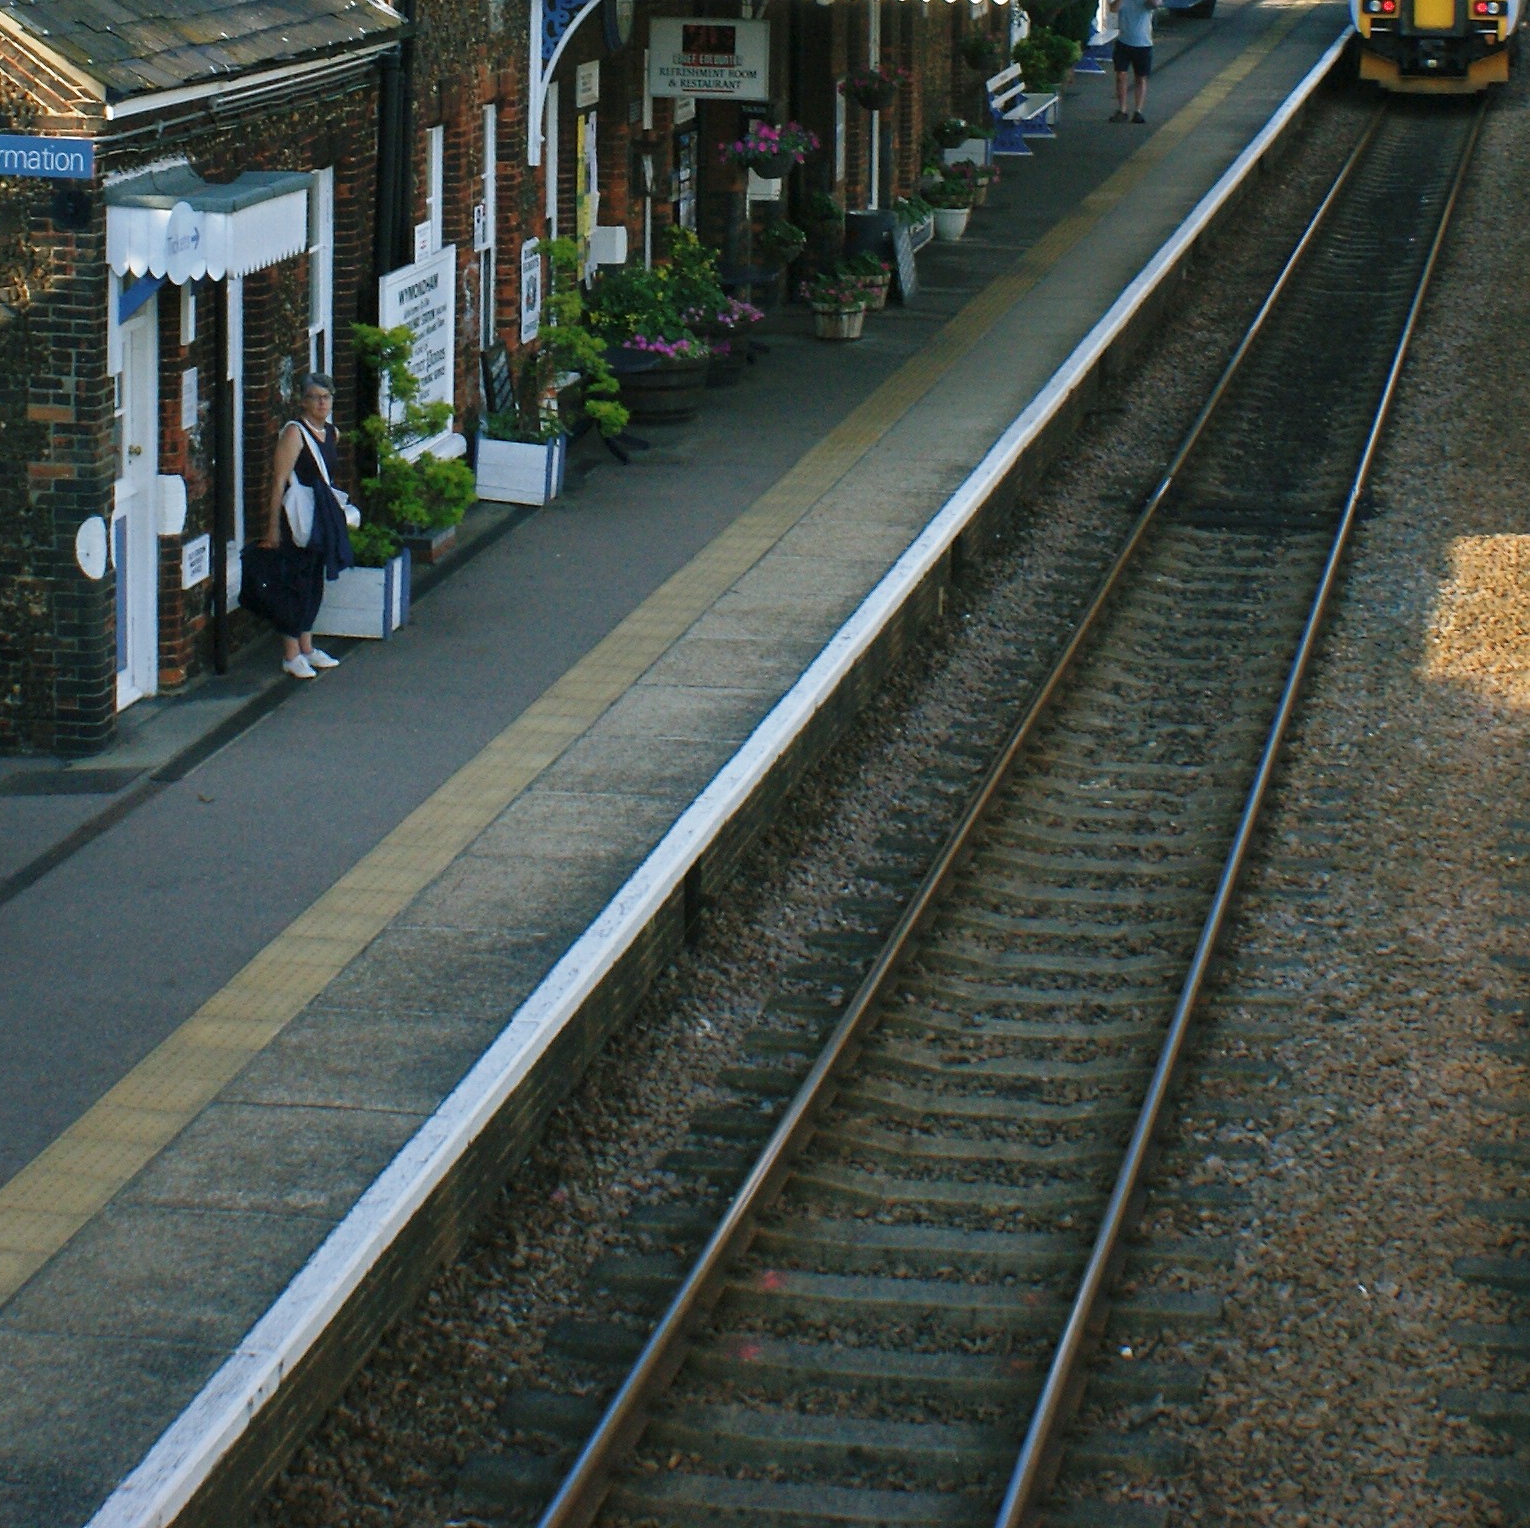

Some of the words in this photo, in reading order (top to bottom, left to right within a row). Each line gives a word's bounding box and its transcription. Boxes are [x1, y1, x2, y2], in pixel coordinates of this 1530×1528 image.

[659, 67, 725, 78] REFRESHMENT
[729, 69, 757, 79] ROOM
[668, 79, 676, 88] &
[679, 79, 742, 89] RESTAURANT
